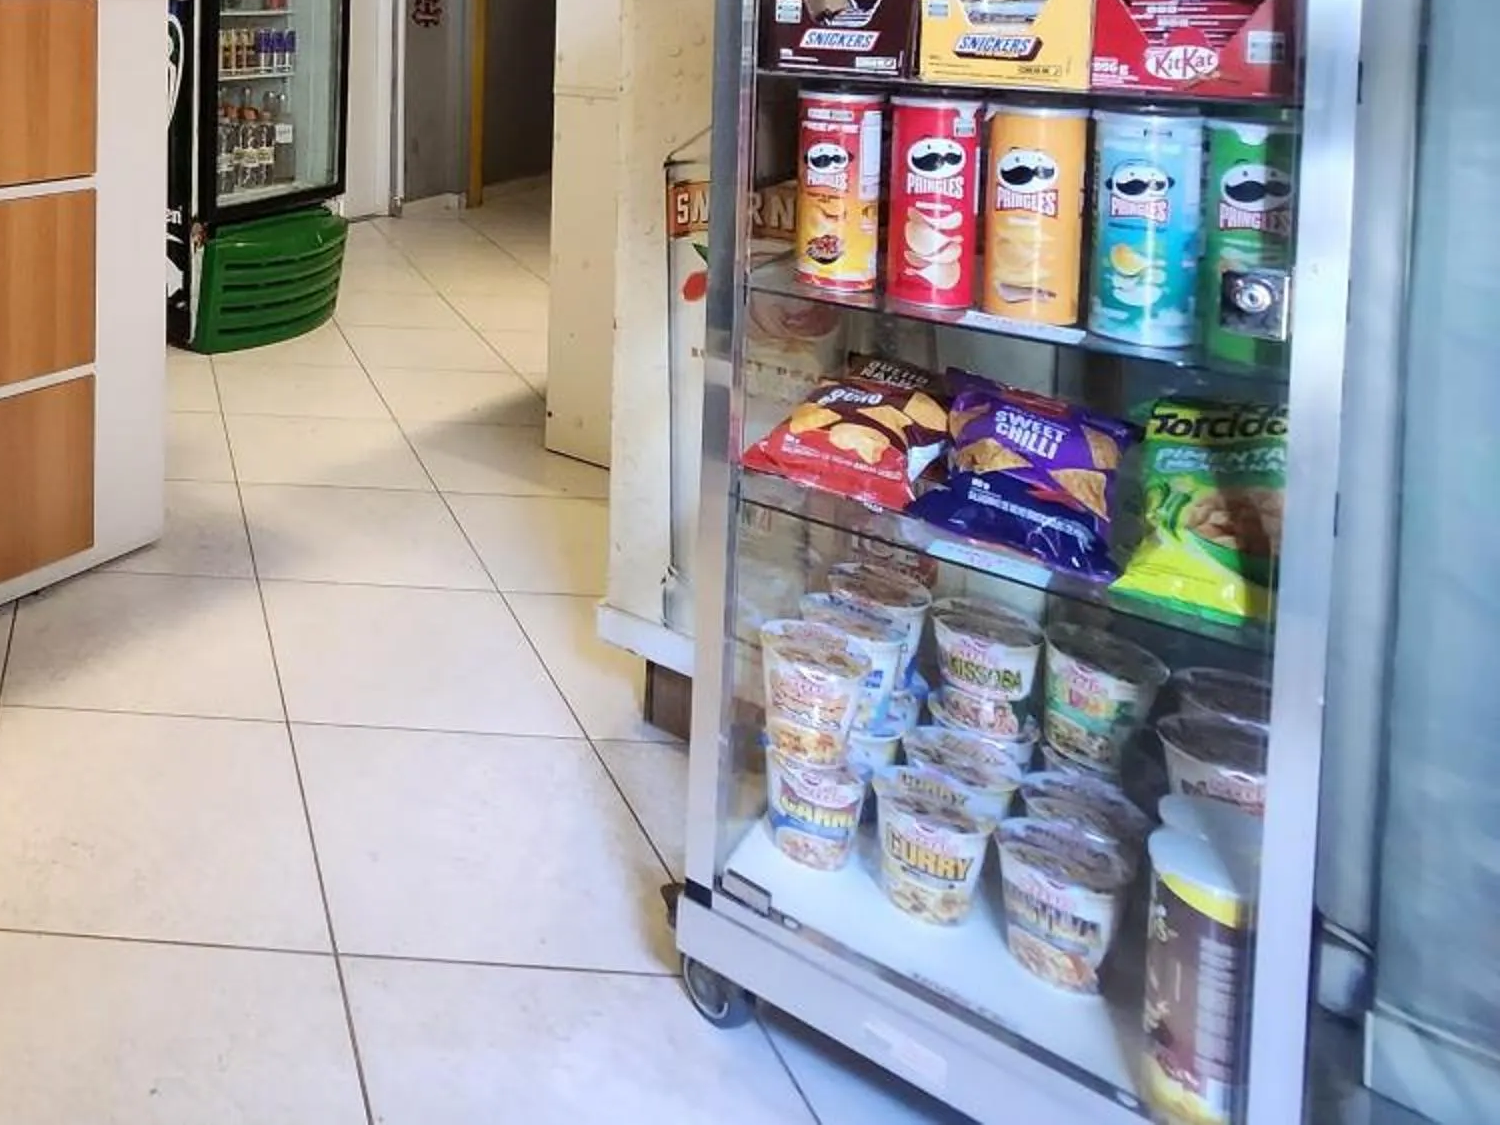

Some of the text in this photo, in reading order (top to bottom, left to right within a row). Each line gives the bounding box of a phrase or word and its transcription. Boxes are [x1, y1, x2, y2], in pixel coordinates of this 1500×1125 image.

[803, 29, 875, 50] SNICKERS
[958, 34, 1032, 54] SNICKERS
[1154, 47, 1215, 78] KitKat
[906, 172, 965, 199] PRINGLES
[995, 183, 1059, 218] PRINGLES
[1110, 196, 1170, 223] PRINGLES
[1219, 202, 1291, 236] PRINGLES
[995, 410, 1069, 442] SWEET
[995, 423, 1060, 460] CHILLI
